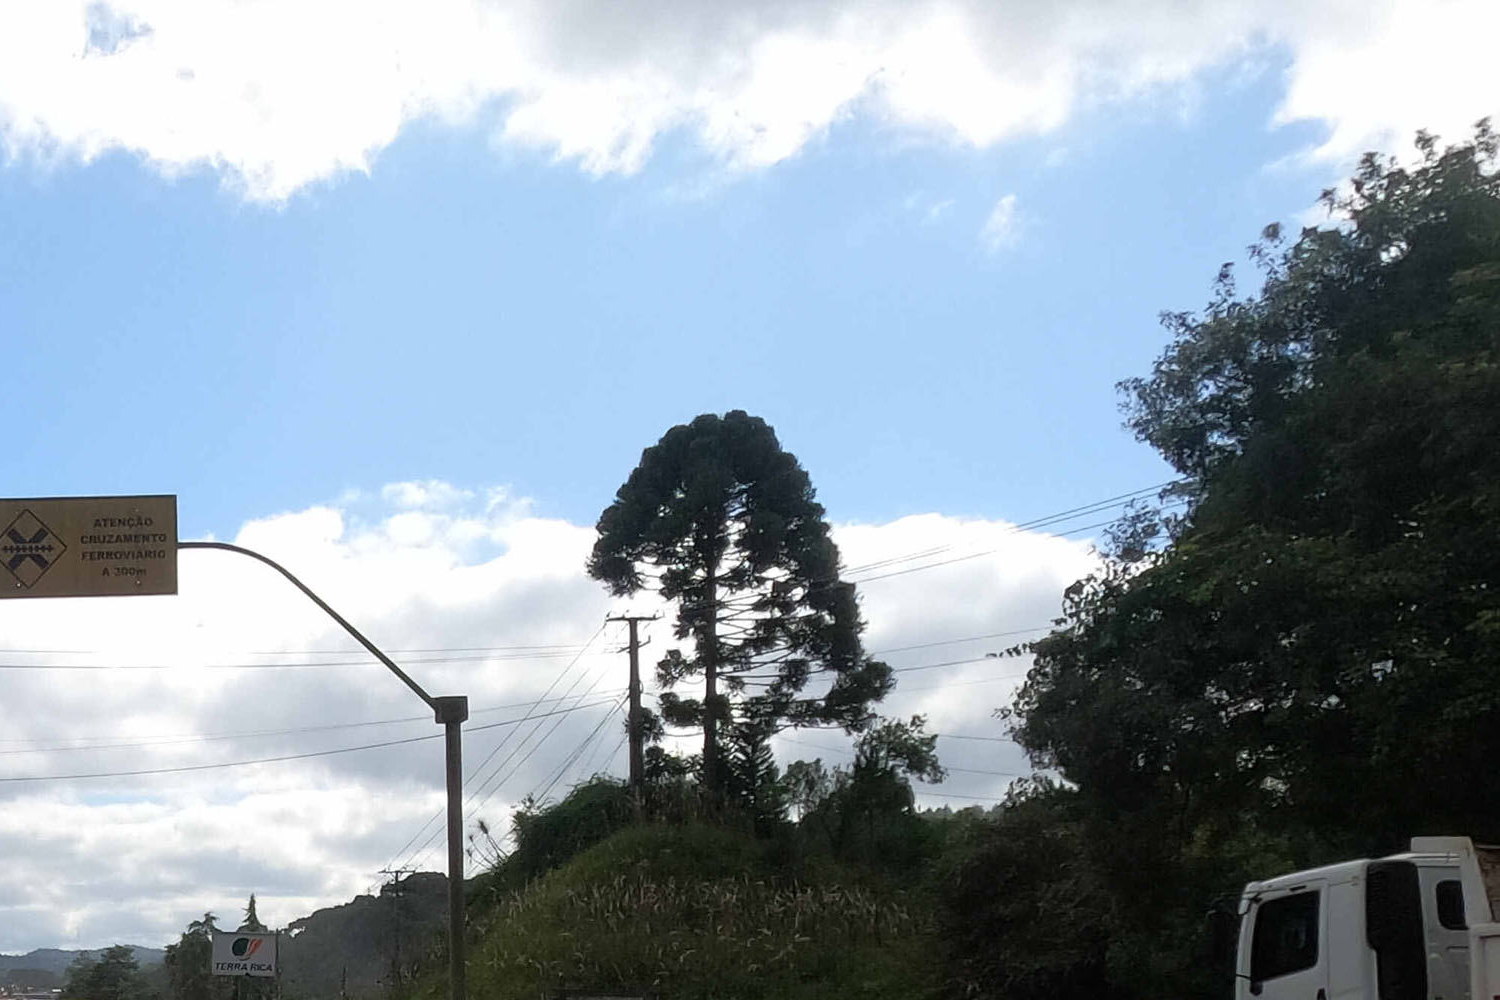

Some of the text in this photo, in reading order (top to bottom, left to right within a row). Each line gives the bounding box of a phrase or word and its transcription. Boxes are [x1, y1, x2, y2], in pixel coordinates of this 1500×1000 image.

[94, 517, 153, 528] ATENÇÃO
[80, 534, 167, 544] CRUZAMENTO
[102, 567, 110, 576] A
[216, 963, 248, 971] TERRA
